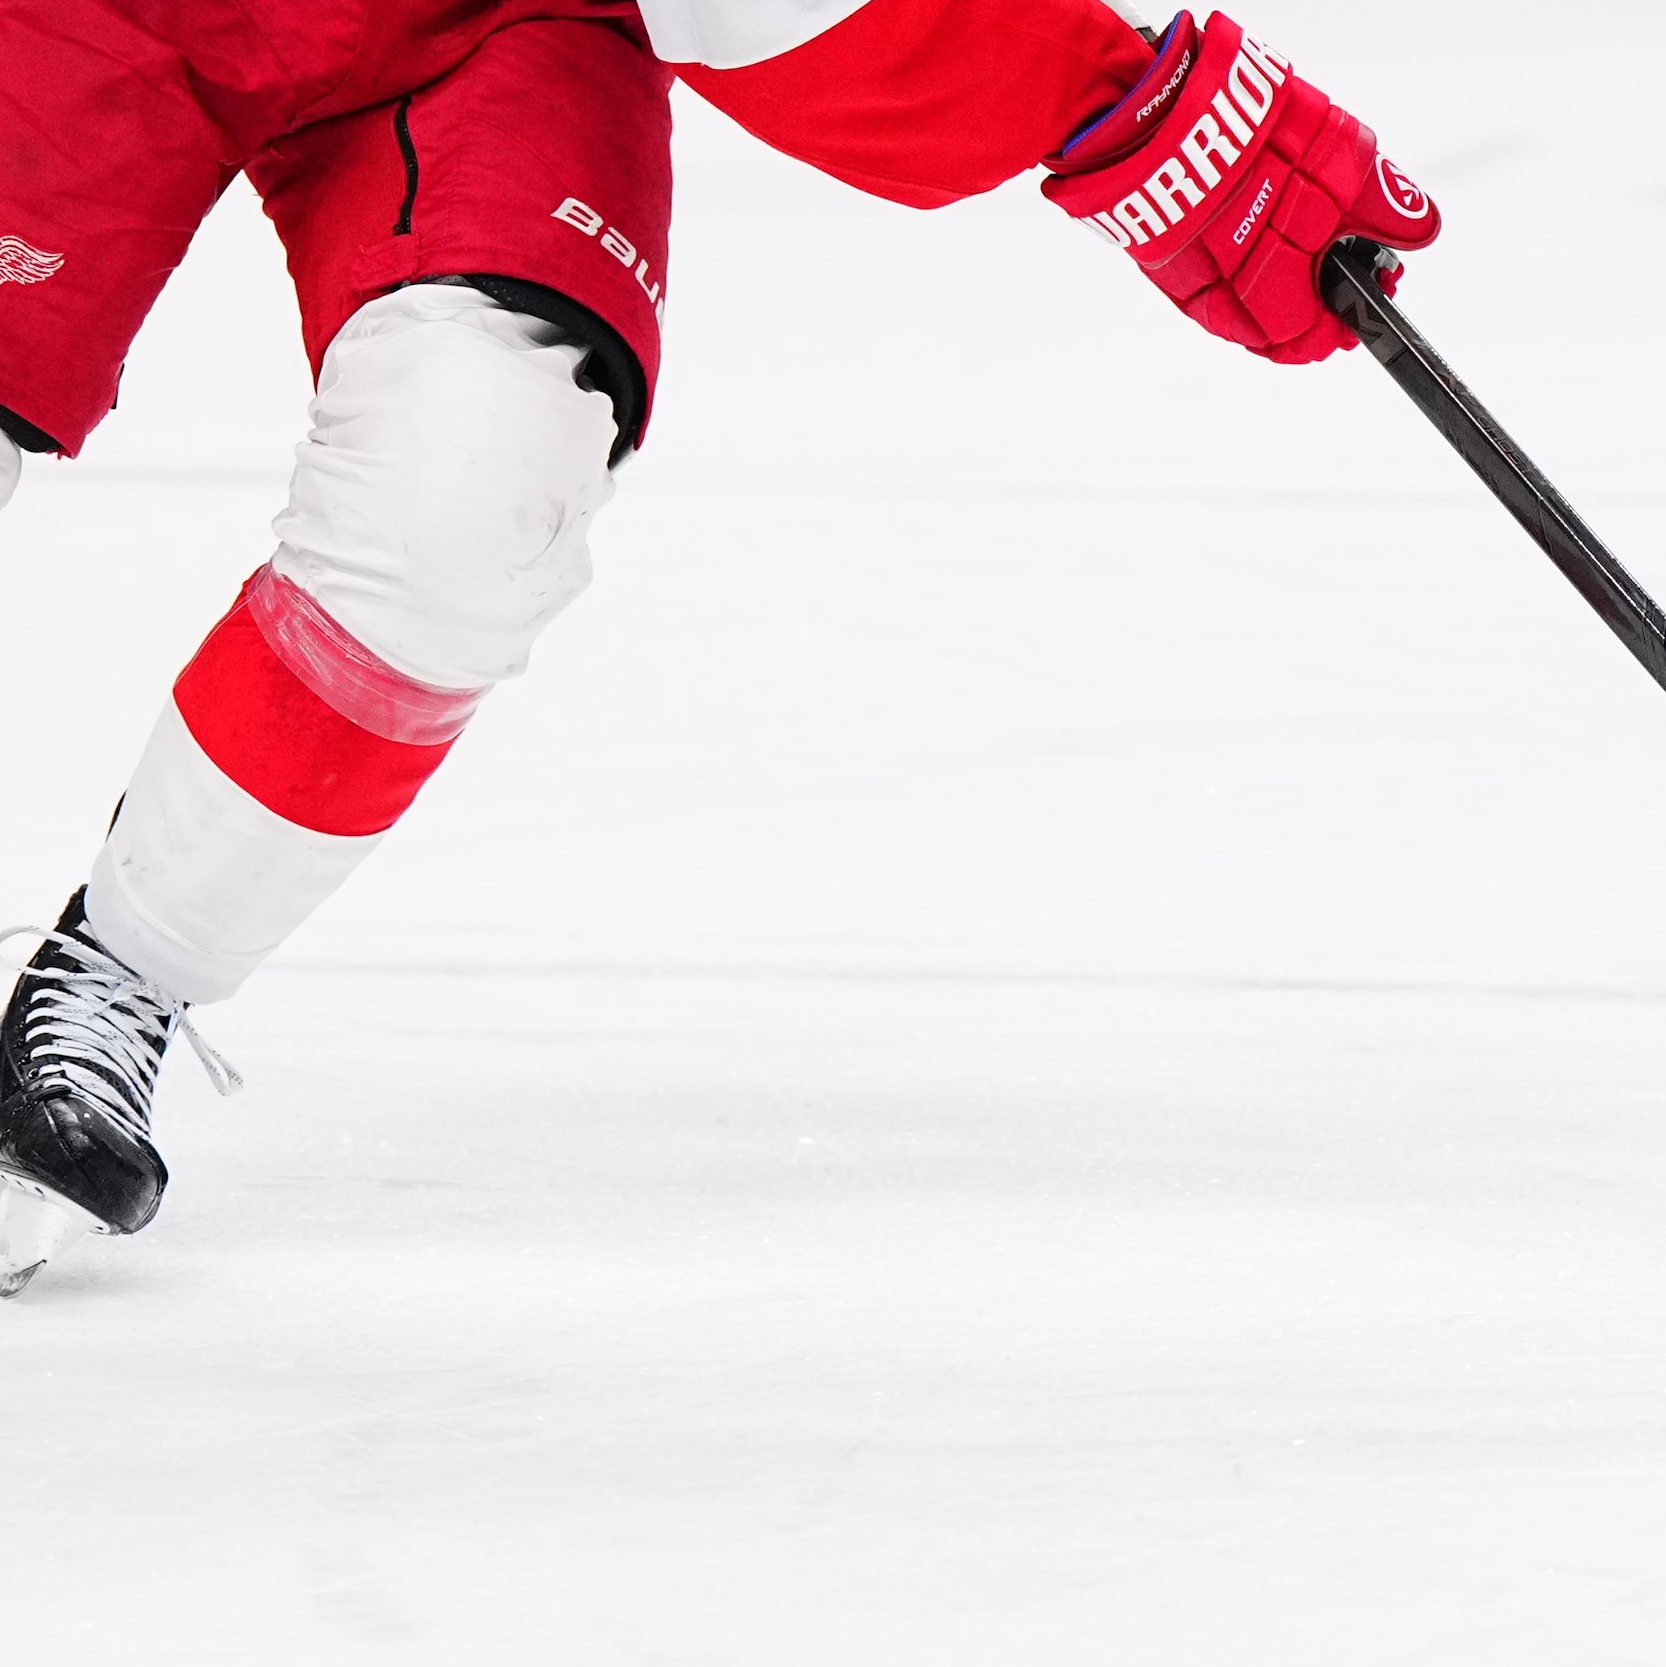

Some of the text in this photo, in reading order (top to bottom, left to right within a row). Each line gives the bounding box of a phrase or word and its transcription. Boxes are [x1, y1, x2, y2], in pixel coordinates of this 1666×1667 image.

[1136, 49, 1190, 123] RAYMOND
[1233, 178, 1273, 245] COVERT
[550, 197, 664, 331] BAU
